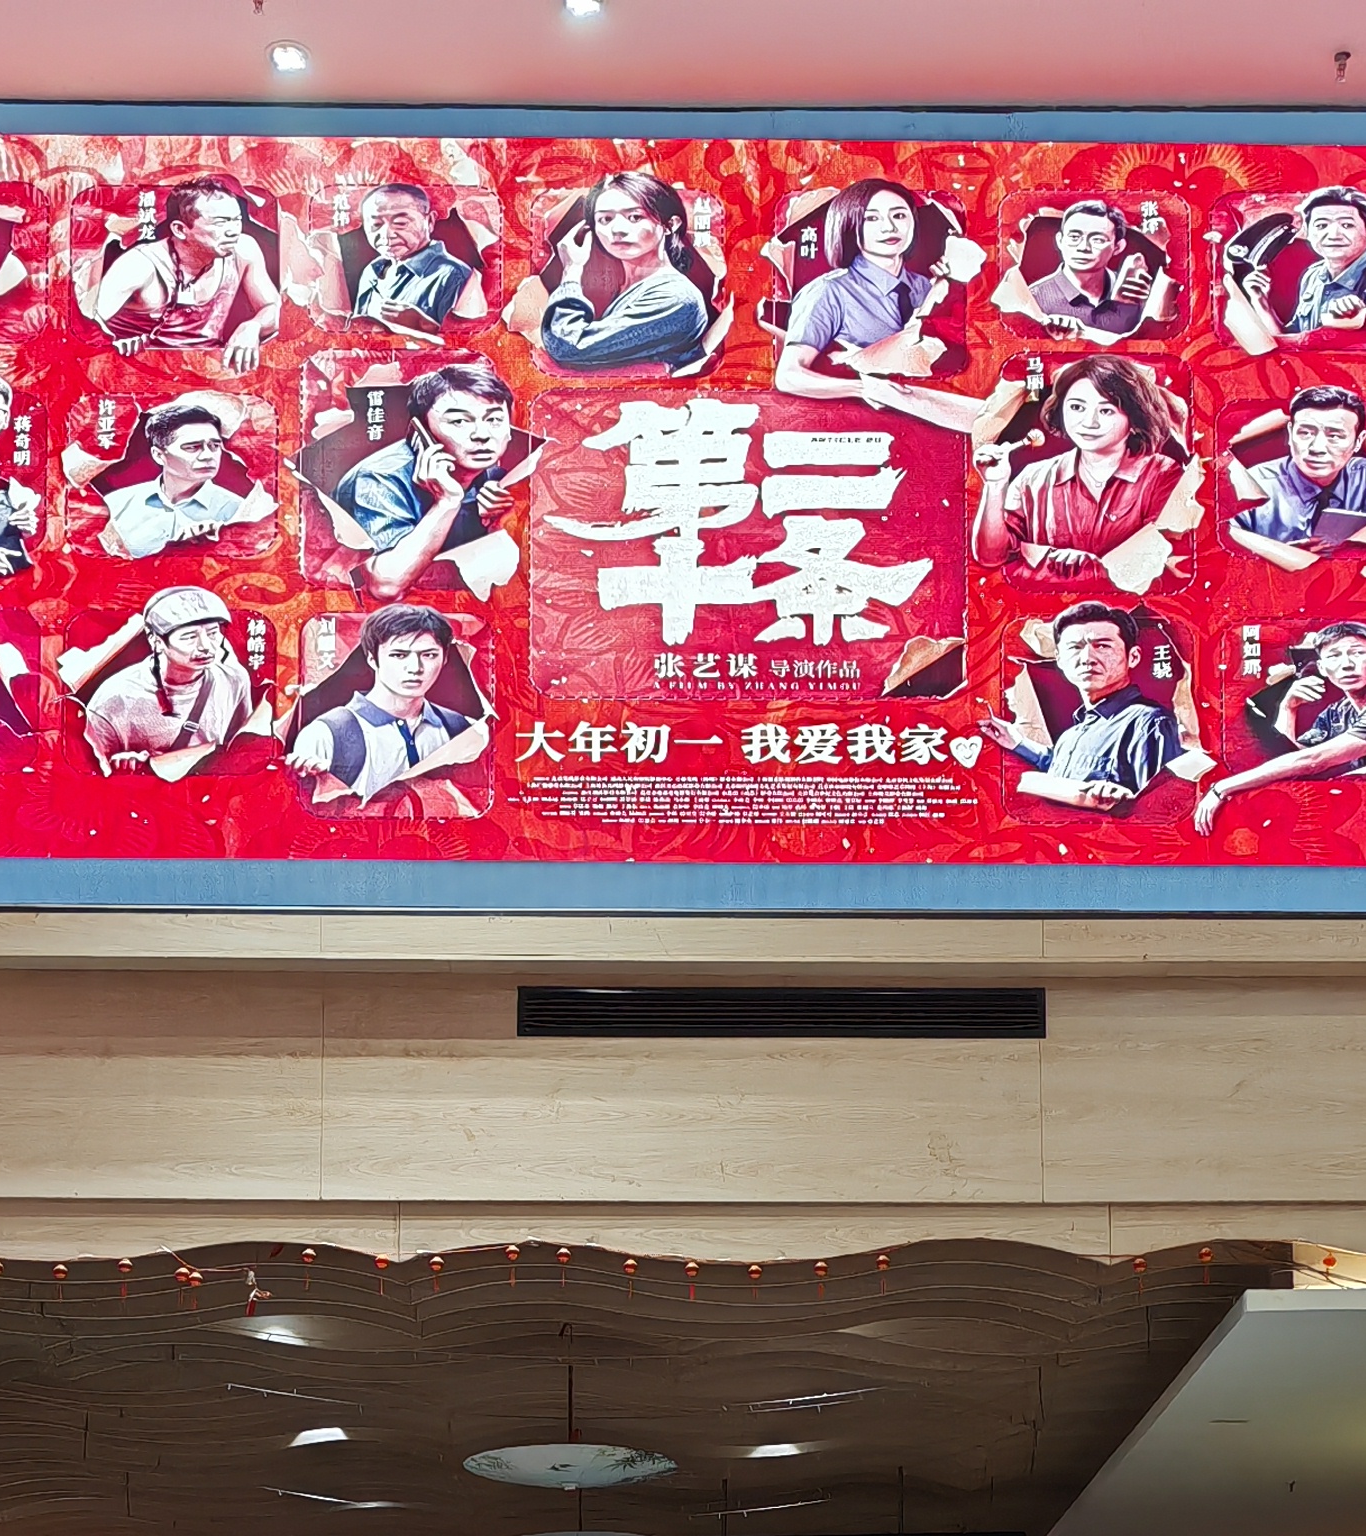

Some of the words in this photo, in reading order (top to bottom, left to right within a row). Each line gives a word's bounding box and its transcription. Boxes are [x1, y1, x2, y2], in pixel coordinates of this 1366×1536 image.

[800, 226, 818, 259] 高叶
[97, 399, 116, 450] 许亚军
[367, 389, 386, 440] 雷佳音
[13, 415, 32, 466] 蒋奇明
[654, 652, 758, 678] 张艺谋
[769, 660, 860, 678] 导演作品
[1242, 624, 1262, 676] 阿如那
[515, 722, 722, 764] 大年初一
[742, 723, 949, 764] 我爱我家
